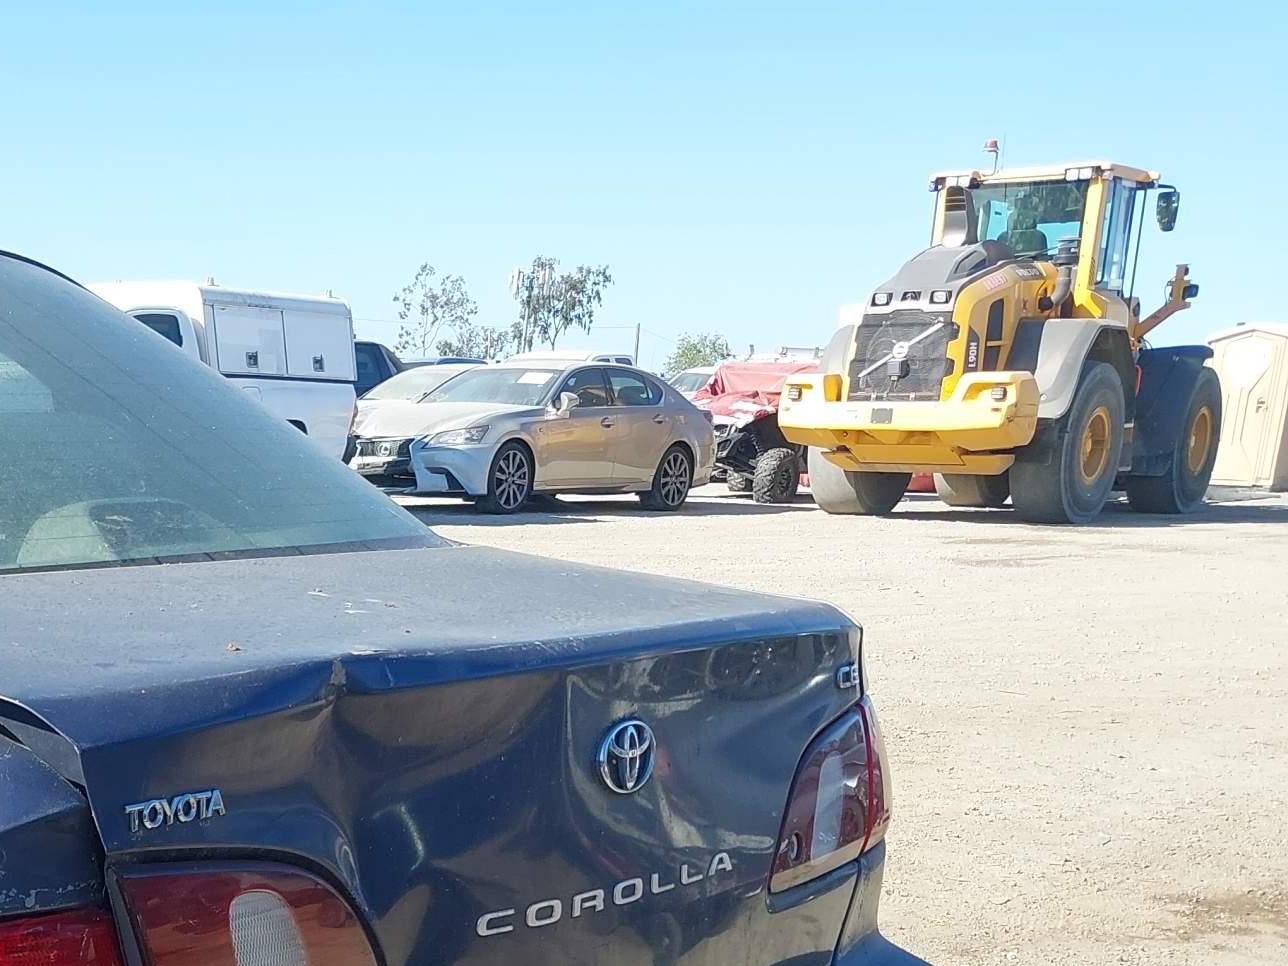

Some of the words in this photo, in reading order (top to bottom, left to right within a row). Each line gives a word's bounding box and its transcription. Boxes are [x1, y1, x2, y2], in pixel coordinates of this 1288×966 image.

[968, 342, 978, 368] L90H
[123, 789, 226, 833] TOYOTA
[475, 851, 733, 937] COROLLA
